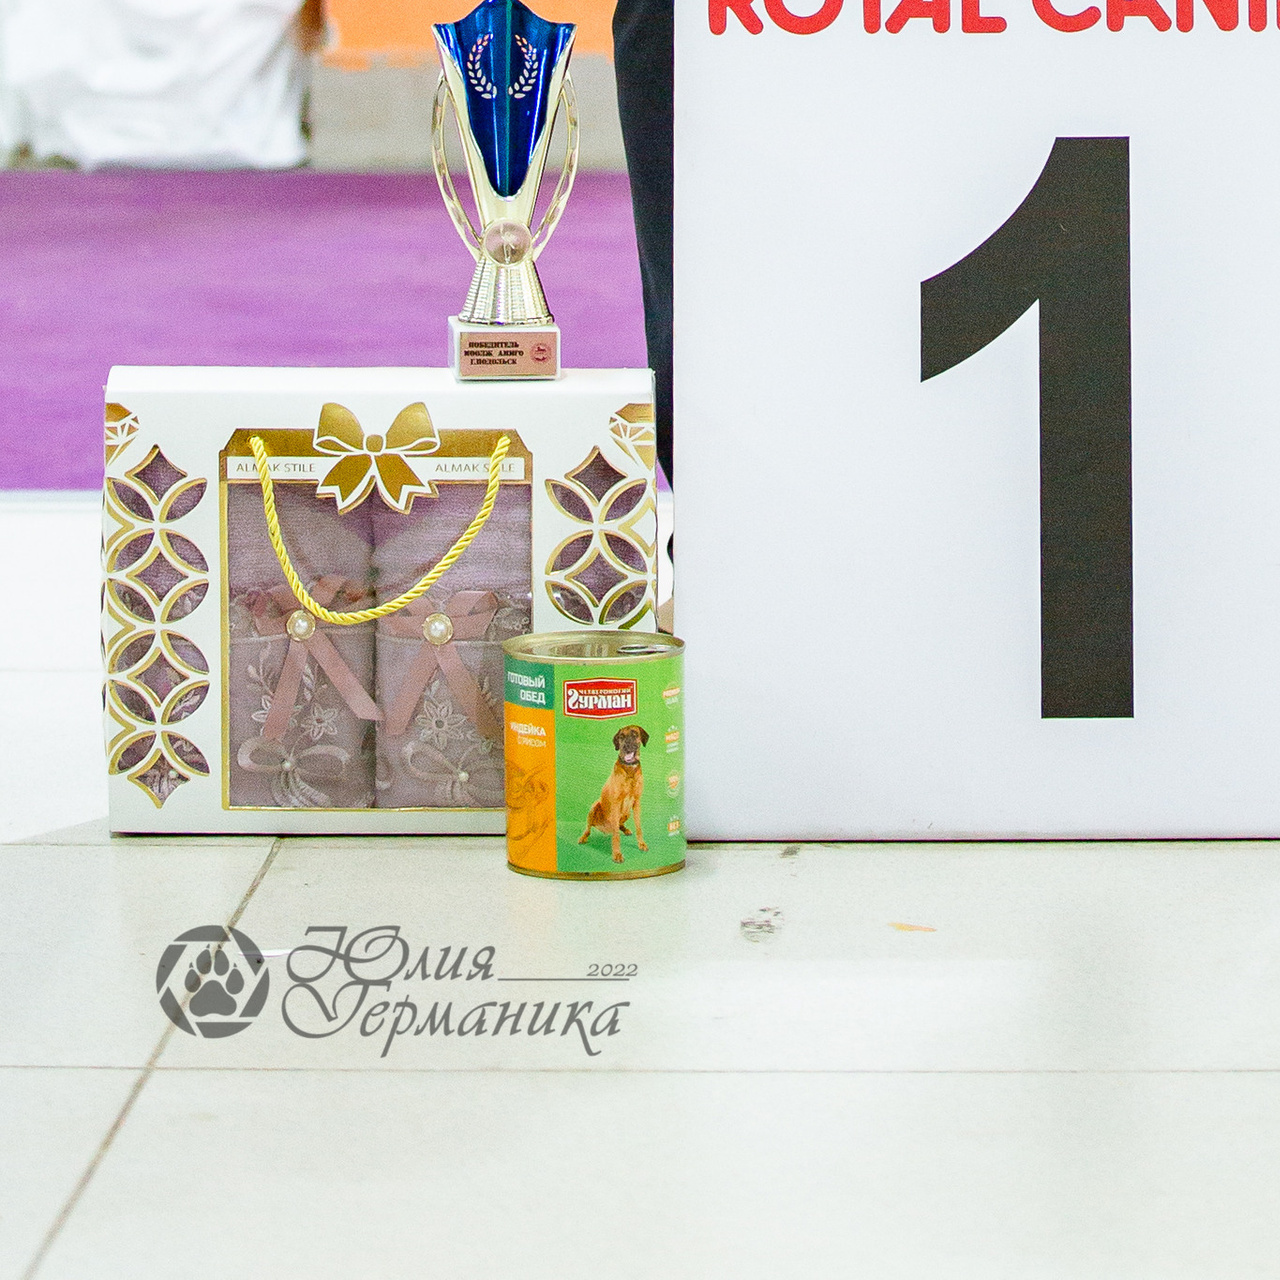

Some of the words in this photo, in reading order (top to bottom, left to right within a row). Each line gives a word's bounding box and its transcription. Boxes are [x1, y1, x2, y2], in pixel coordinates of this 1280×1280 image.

[919, 136, 1134, 719] 1
[284, 463, 316, 473] STILE
[435, 463, 480, 473] ALMAK
[483, 463, 515, 473] SLE
[507, 671, 546, 689] ГОТОВЫЙ
[519, 689, 546, 706] ОБЕД
